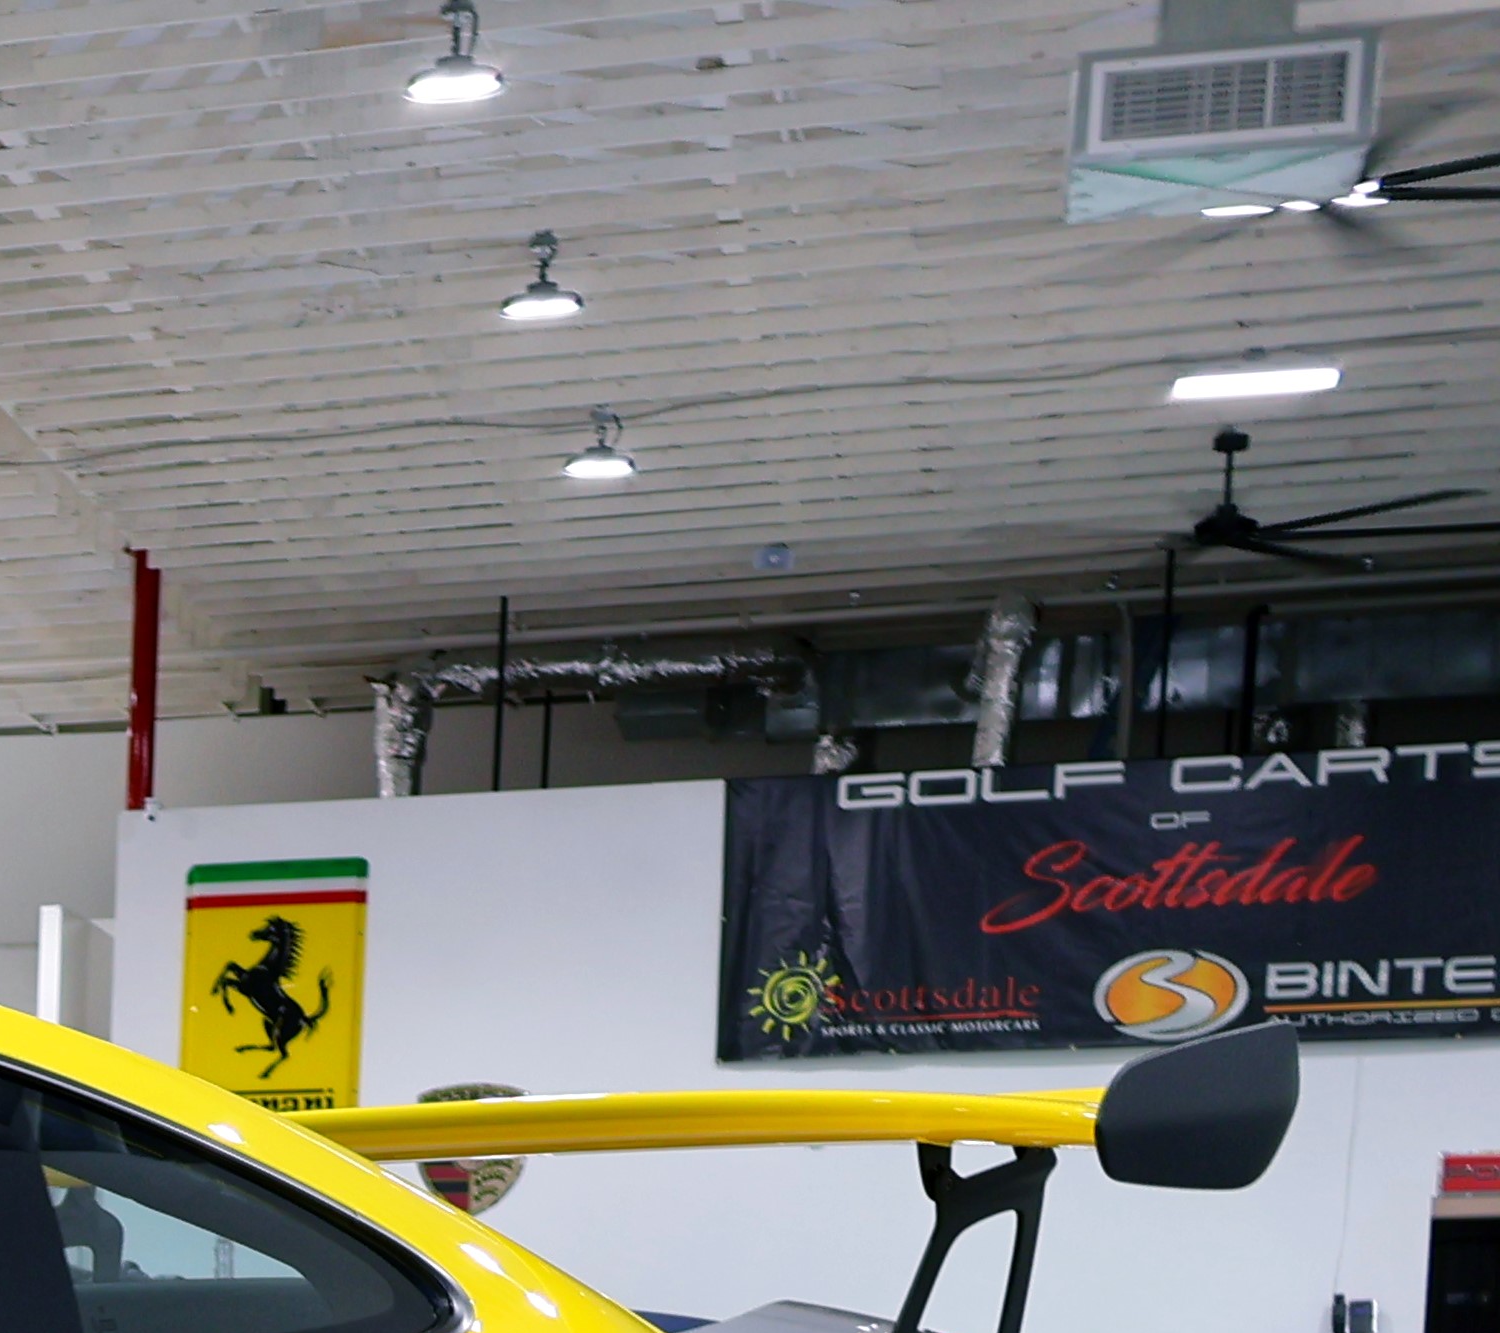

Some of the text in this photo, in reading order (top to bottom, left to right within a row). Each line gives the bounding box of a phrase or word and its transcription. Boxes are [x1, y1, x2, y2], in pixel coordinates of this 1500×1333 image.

[837, 760, 1126, 811] GOLF
[1151, 810, 1211, 831] OF
[979, 834, 1380, 935] Scottsdale
[821, 975, 1042, 1014] Scottsdale
[821, 1022, 872, 1037] SPORTS
[890, 1020, 947, 1036] CLASSIC
[950, 1018, 1042, 1034] MOTORCARS
